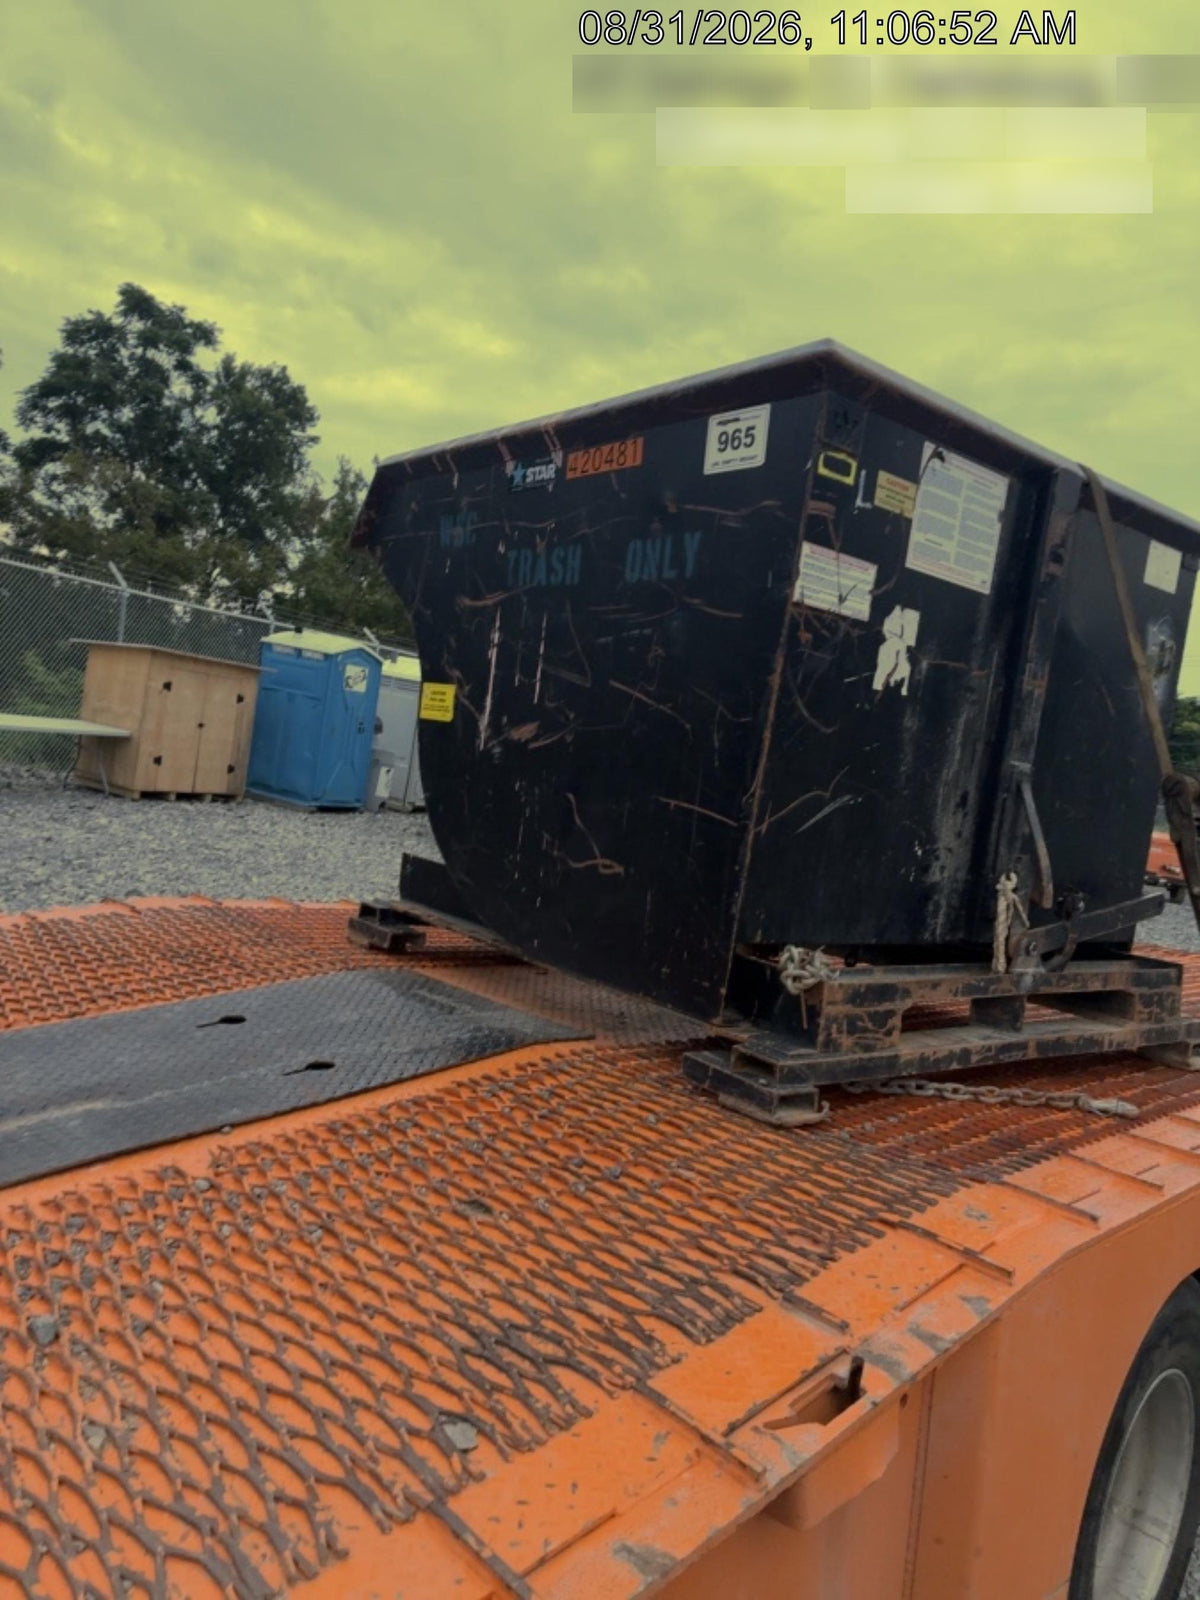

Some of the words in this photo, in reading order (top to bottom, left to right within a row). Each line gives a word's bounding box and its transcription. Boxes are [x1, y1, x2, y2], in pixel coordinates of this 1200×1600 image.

[717, 425, 756, 453] 965
[568, 440, 638, 475] 420481
[525, 464, 556, 483] STAR
[507, 544, 582, 587] TRASH
[625, 530, 702, 584] ONLY
